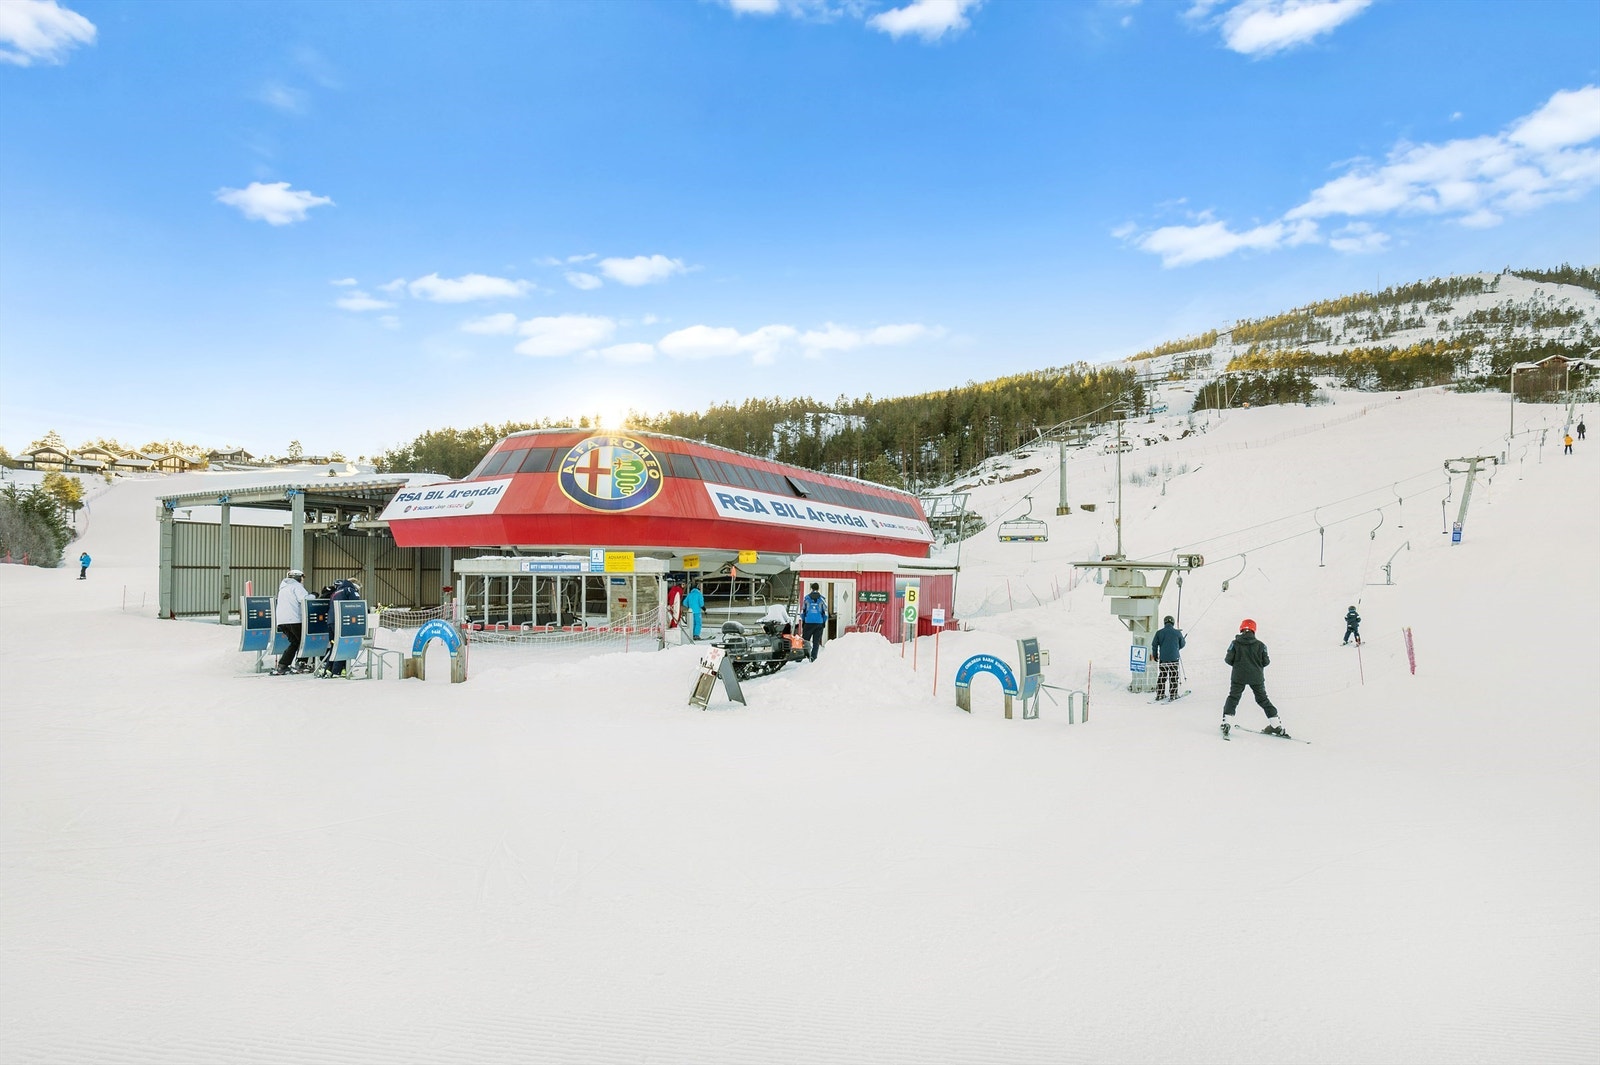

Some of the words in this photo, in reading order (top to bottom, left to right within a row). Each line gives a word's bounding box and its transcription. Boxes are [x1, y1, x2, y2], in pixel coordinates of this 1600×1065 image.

[563, 440, 599, 475] ALFA
[608, 437, 660, 480] ROMEO
[395, 492, 422, 502] RSA
[424, 490, 445, 501] BIL
[446, 485, 504, 499] Arendal
[715, 492, 770, 515] RSA
[769, 500, 806, 520] BIL
[805, 506, 868, 529] Arendal
[908, 590, 916, 602] B
[907, 608, 915, 620] 2
